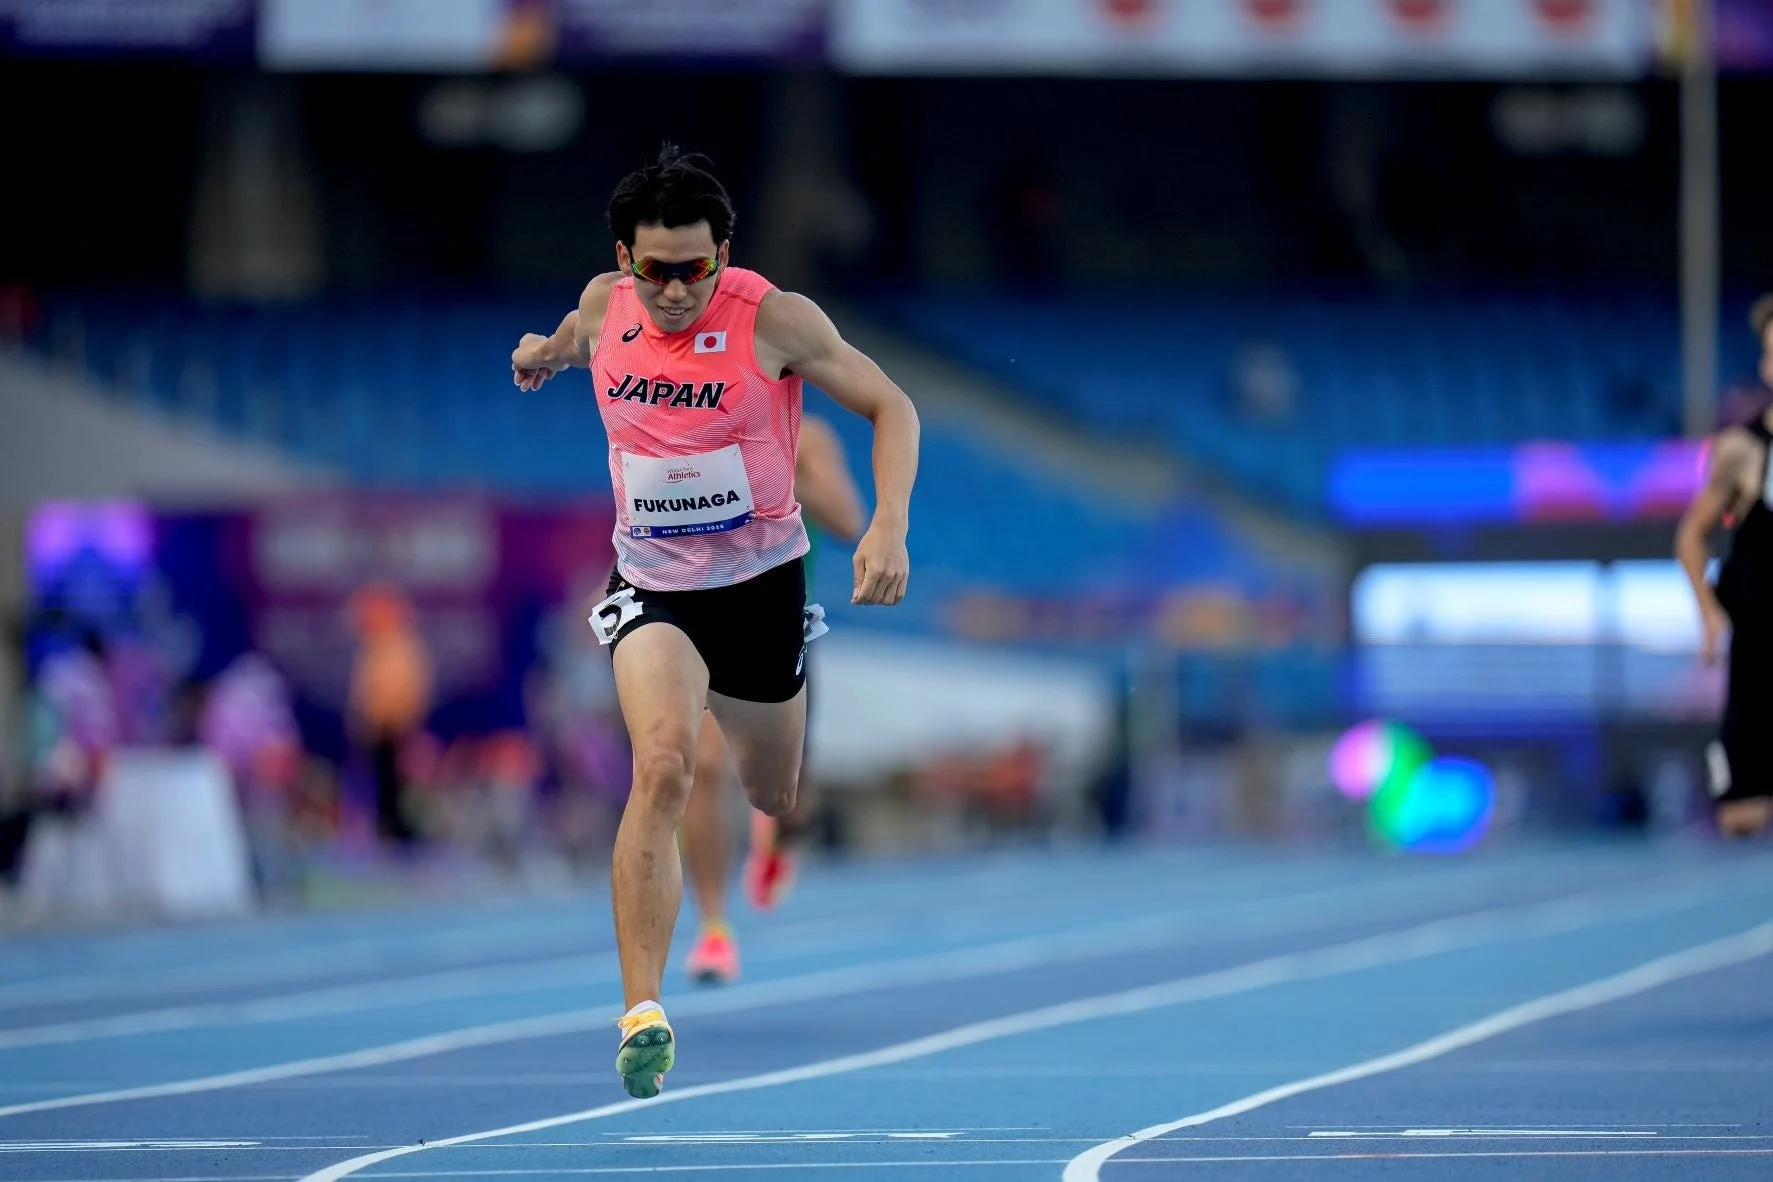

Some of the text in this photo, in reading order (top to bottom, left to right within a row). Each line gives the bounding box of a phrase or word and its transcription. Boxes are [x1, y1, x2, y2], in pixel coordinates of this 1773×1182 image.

[607, 373, 725, 409] JAPAN
[668, 471, 701, 480] Athletics
[633, 490, 741, 513] FUKUNAGA
